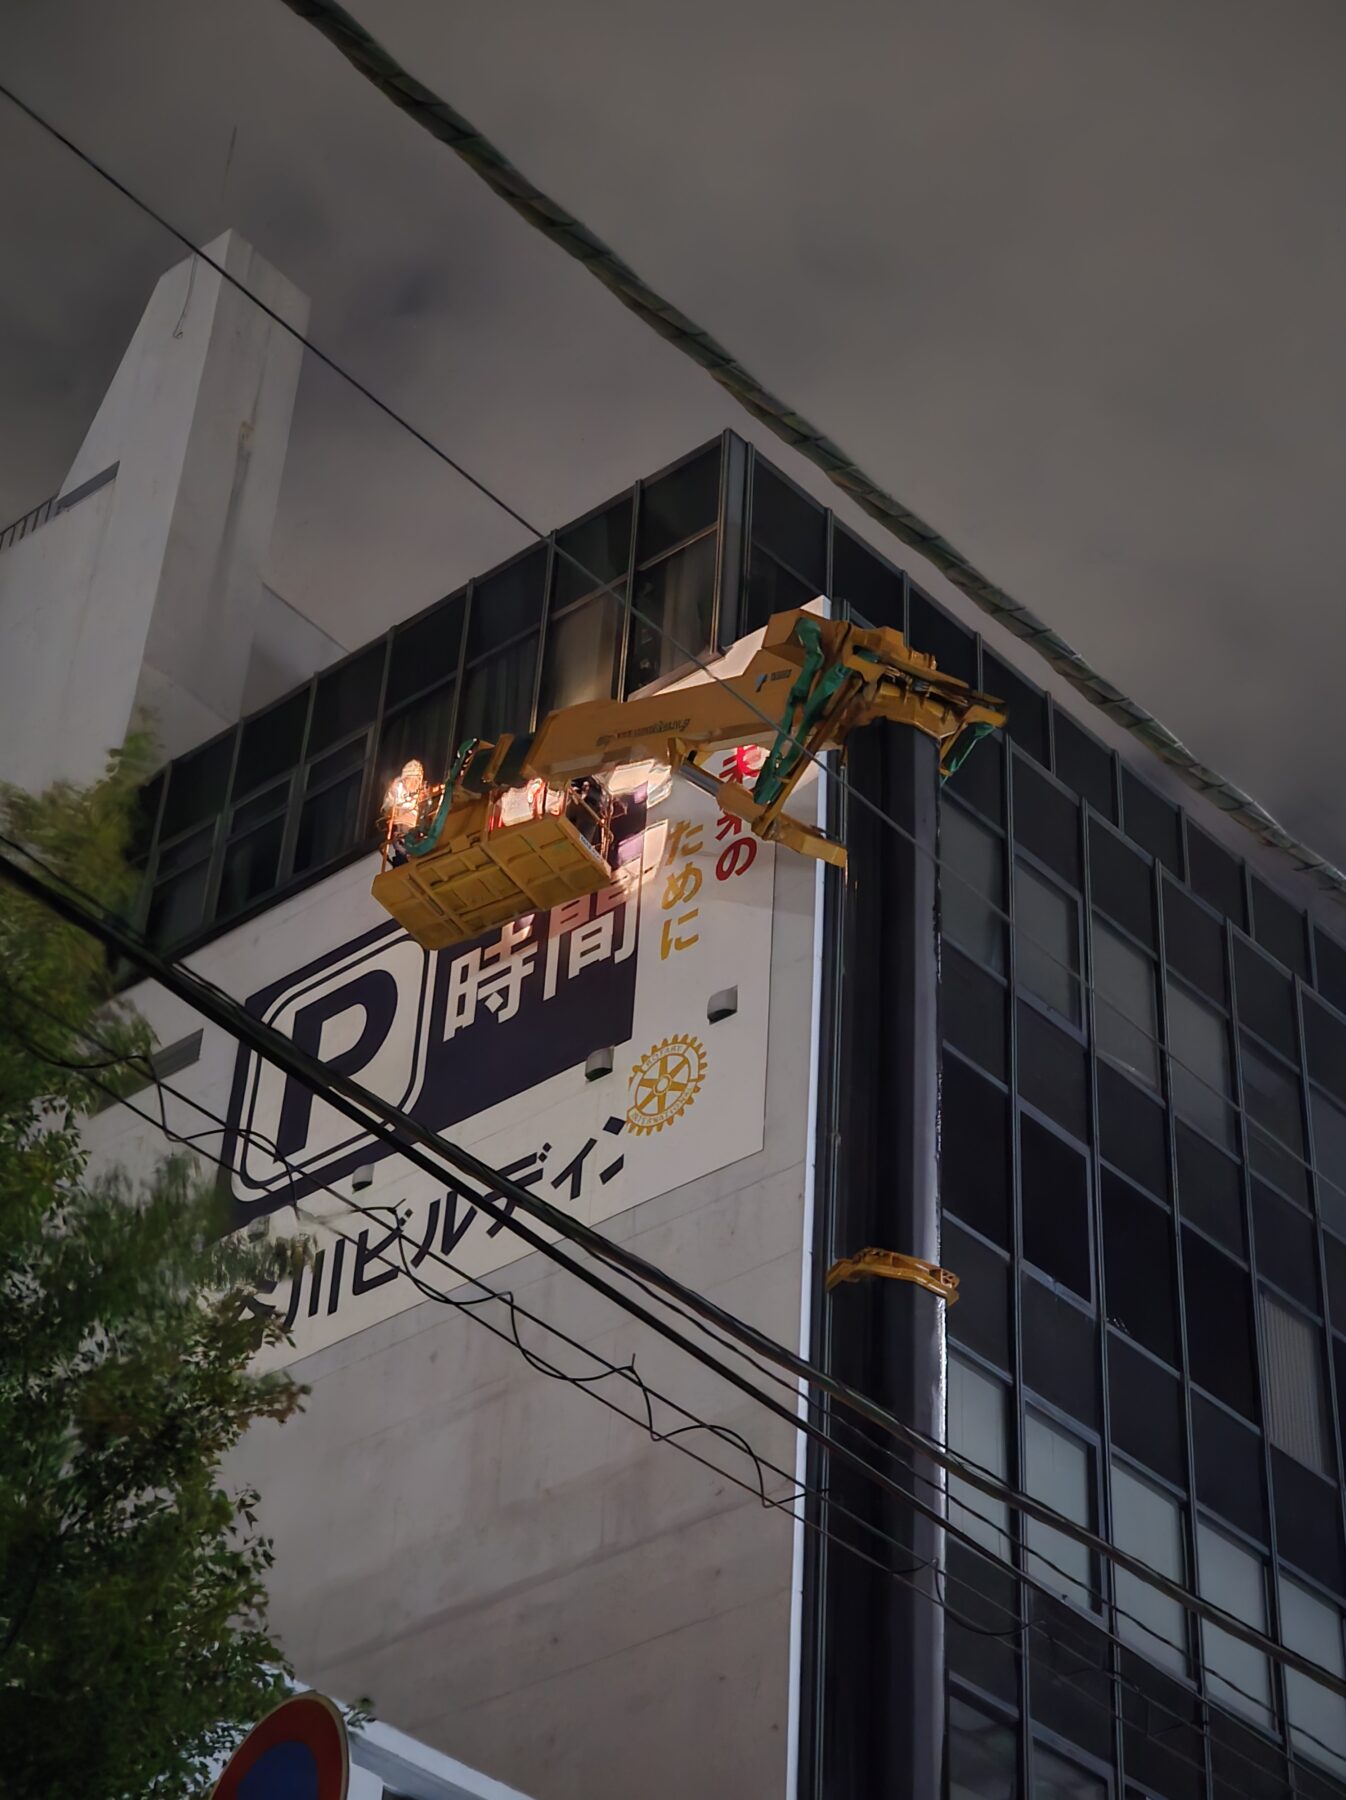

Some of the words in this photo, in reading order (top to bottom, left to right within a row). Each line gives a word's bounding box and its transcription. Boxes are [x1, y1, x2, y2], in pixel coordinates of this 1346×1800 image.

[660, 819, 704, 960] ために
[273, 969, 399, 1162] P
[443, 875, 638, 1042] 時間
